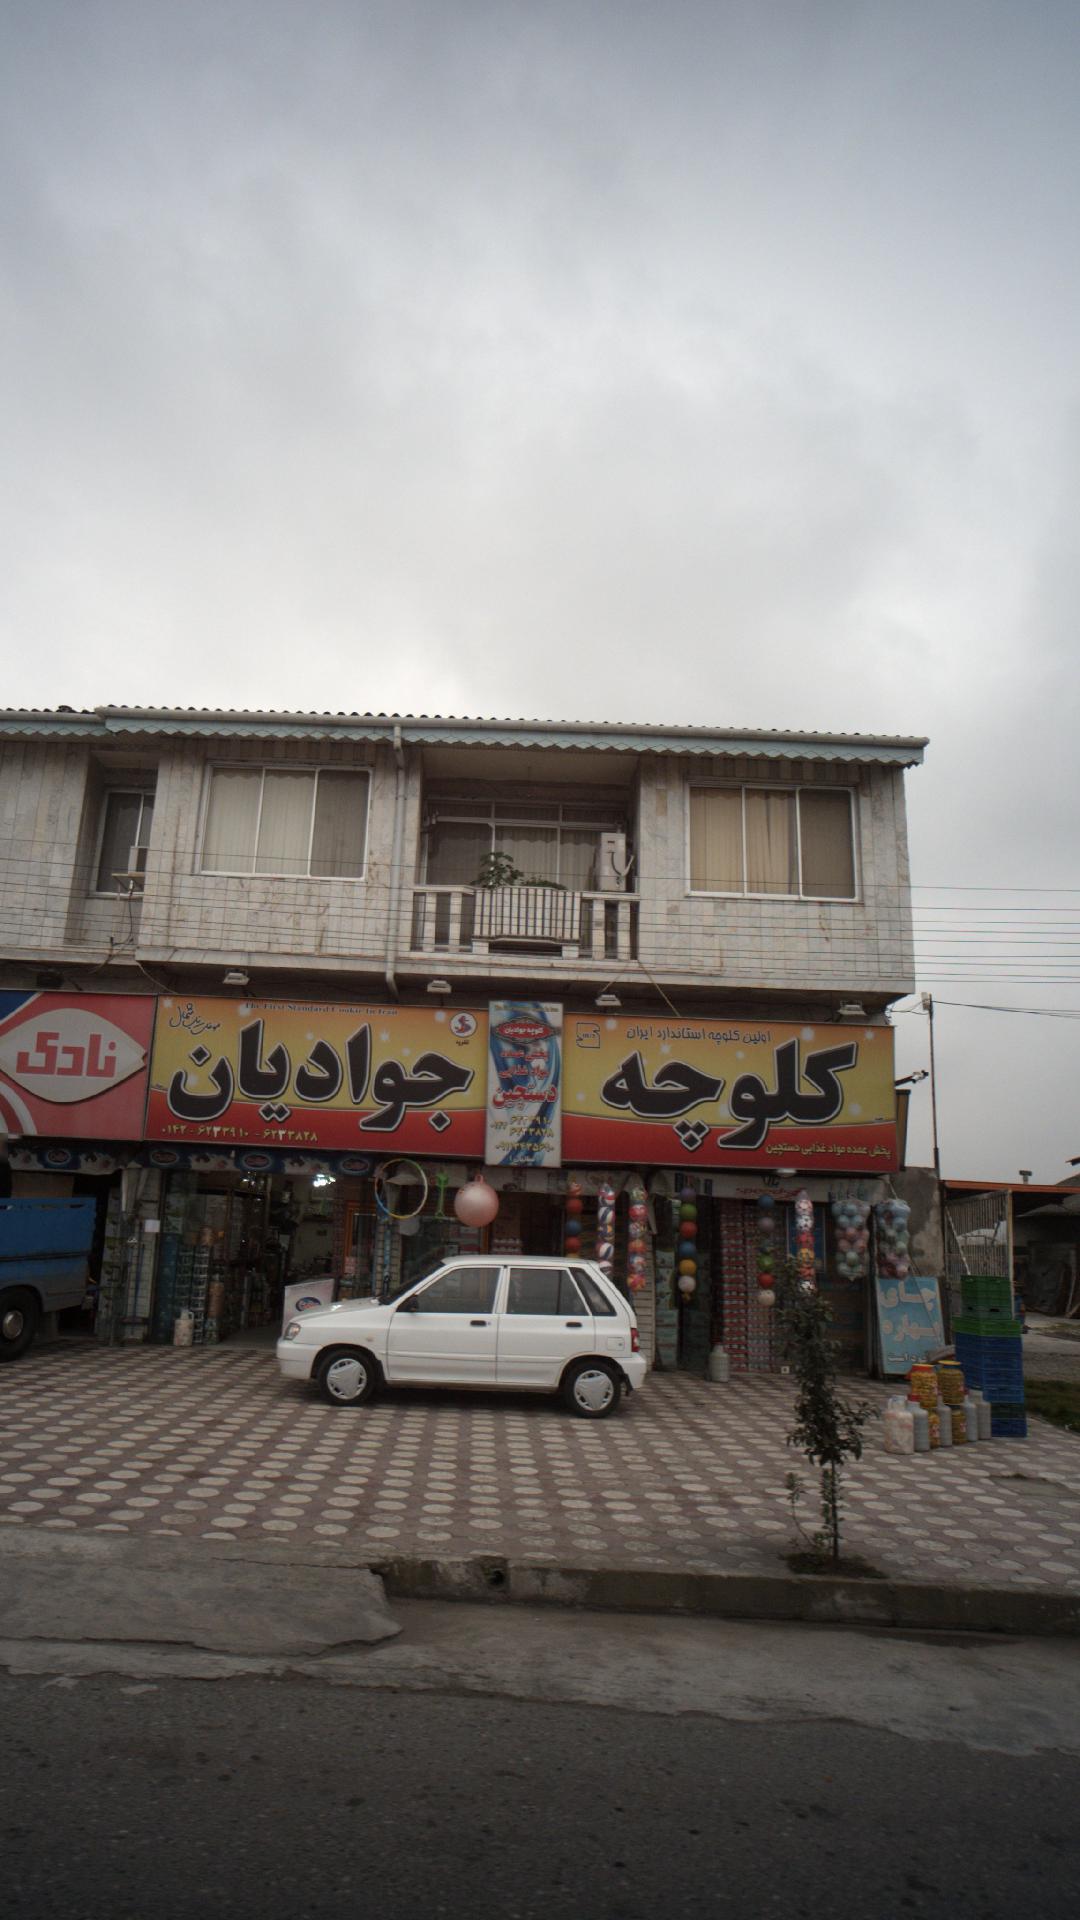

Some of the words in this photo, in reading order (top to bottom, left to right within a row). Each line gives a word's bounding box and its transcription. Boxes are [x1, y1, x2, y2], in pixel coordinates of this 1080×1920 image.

[263, 1003, 285, 1011] First
[287, 1004, 329, 1014] Standard
[626, 1025, 652, 1041] ایران
[656, 1026, 706, 1042] استاندارد
[708, 1029, 740, 1045] کلوچه
[743, 1029, 771, 1045] اولین
[168, 1018, 475, 1132] جوادیان
[493, 1084, 558, 1111] دستچین
[601, 1038, 857, 1152] کلوچه
[765, 1142, 801, 1156] دستچین
[827, 1143, 846, 1155] مواد
[847, 1145, 868, 1155] عمده
[869, 1145, 892, 1159] پخش
[879, 1280, 937, 1312] چای
